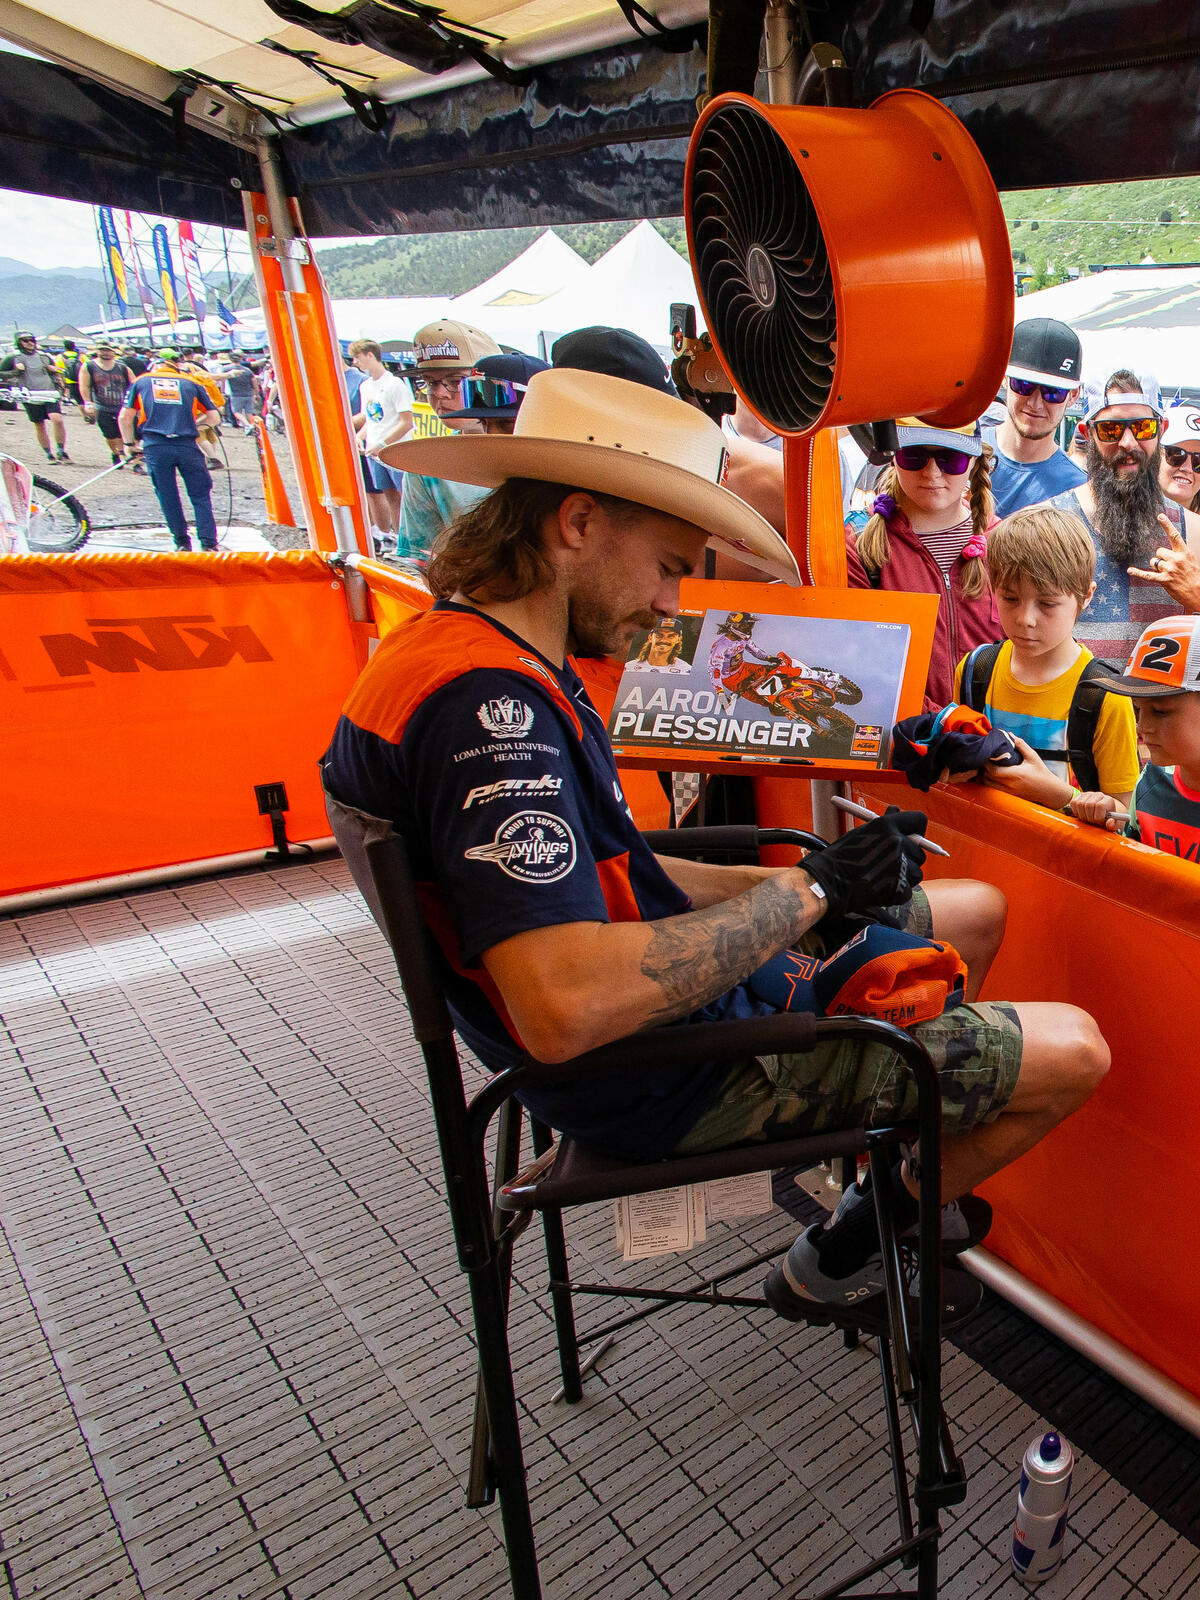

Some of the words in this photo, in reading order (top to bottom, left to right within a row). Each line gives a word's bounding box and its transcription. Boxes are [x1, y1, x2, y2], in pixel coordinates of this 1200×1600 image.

[1139, 636, 1182, 674] 2
[620, 686, 738, 716] AARON
[612, 711, 814, 748] PLESSINGER
[453, 747, 482, 763] LOMA
[481, 742, 513, 755] LINDA
[514, 742, 561, 758] UNIVERSITY
[493, 752, 532, 763] HEALTH
[502, 819, 526, 840] PROUD
[524, 816, 536, 824] TO
[536, 816, 568, 839] SUPPORT
[515, 840, 570, 856] WINGS
[524, 852, 557, 865] LIFE
